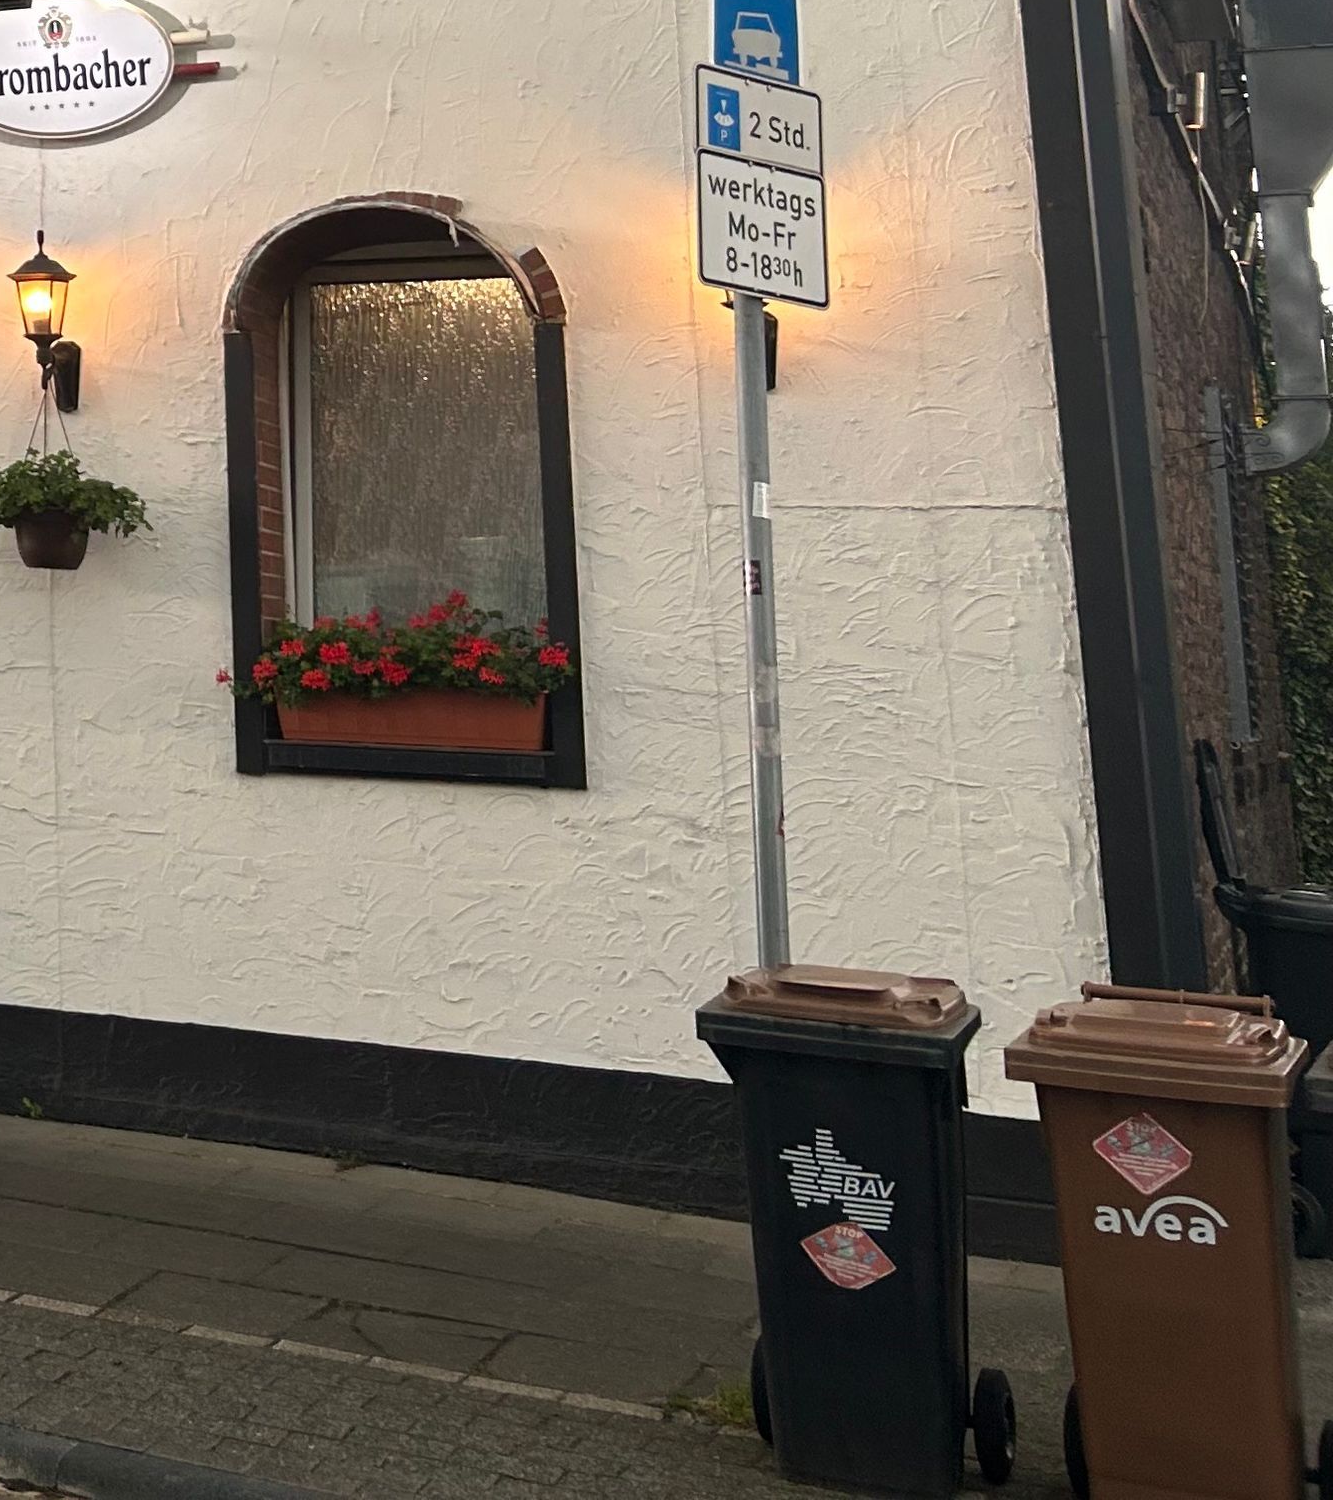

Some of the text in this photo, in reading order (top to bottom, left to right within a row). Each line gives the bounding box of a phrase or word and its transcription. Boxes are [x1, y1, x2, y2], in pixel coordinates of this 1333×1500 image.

[749, 112, 811, 151] 2 Std.
[708, 174, 816, 222] werktags
[728, 211, 797, 251] Mo-Fr
[843, 1176, 895, 1199] BAV
[835, 1225, 863, 1239] STOP
[1094, 1195, 1229, 1246] avea
